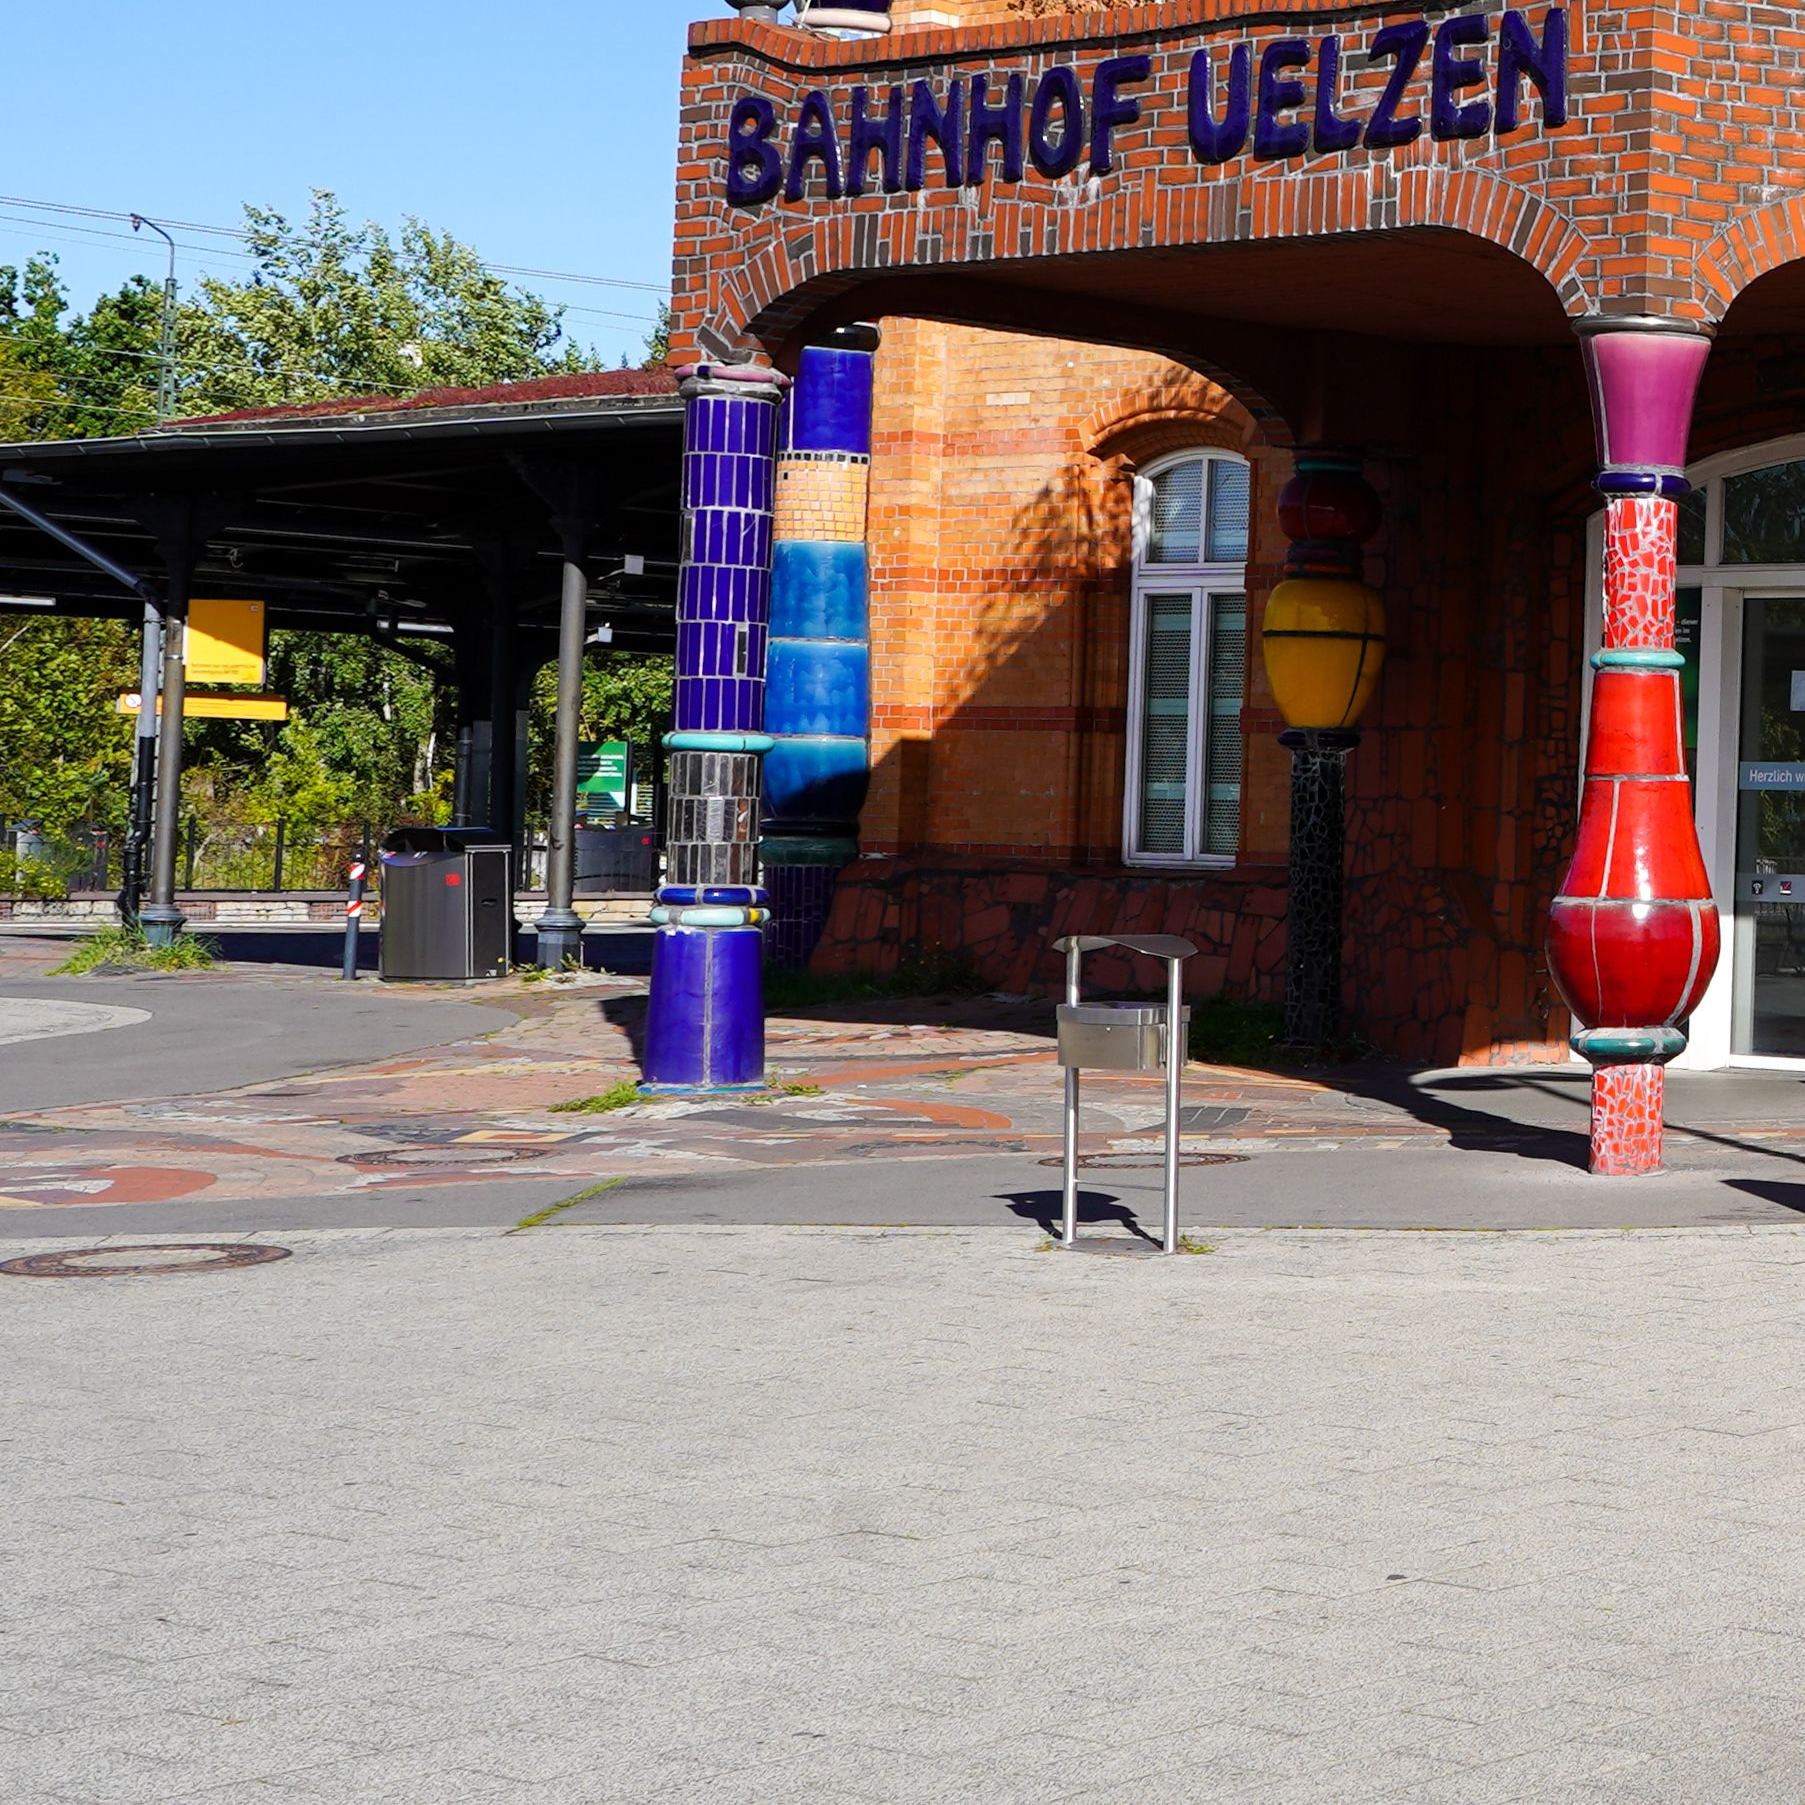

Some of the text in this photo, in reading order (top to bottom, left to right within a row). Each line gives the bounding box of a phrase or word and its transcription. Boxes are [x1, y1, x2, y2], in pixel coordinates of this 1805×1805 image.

[724, 7, 1568, 207] BAHNHOF UELZEN
[1749, 769, 1793, 783] Herzlich
